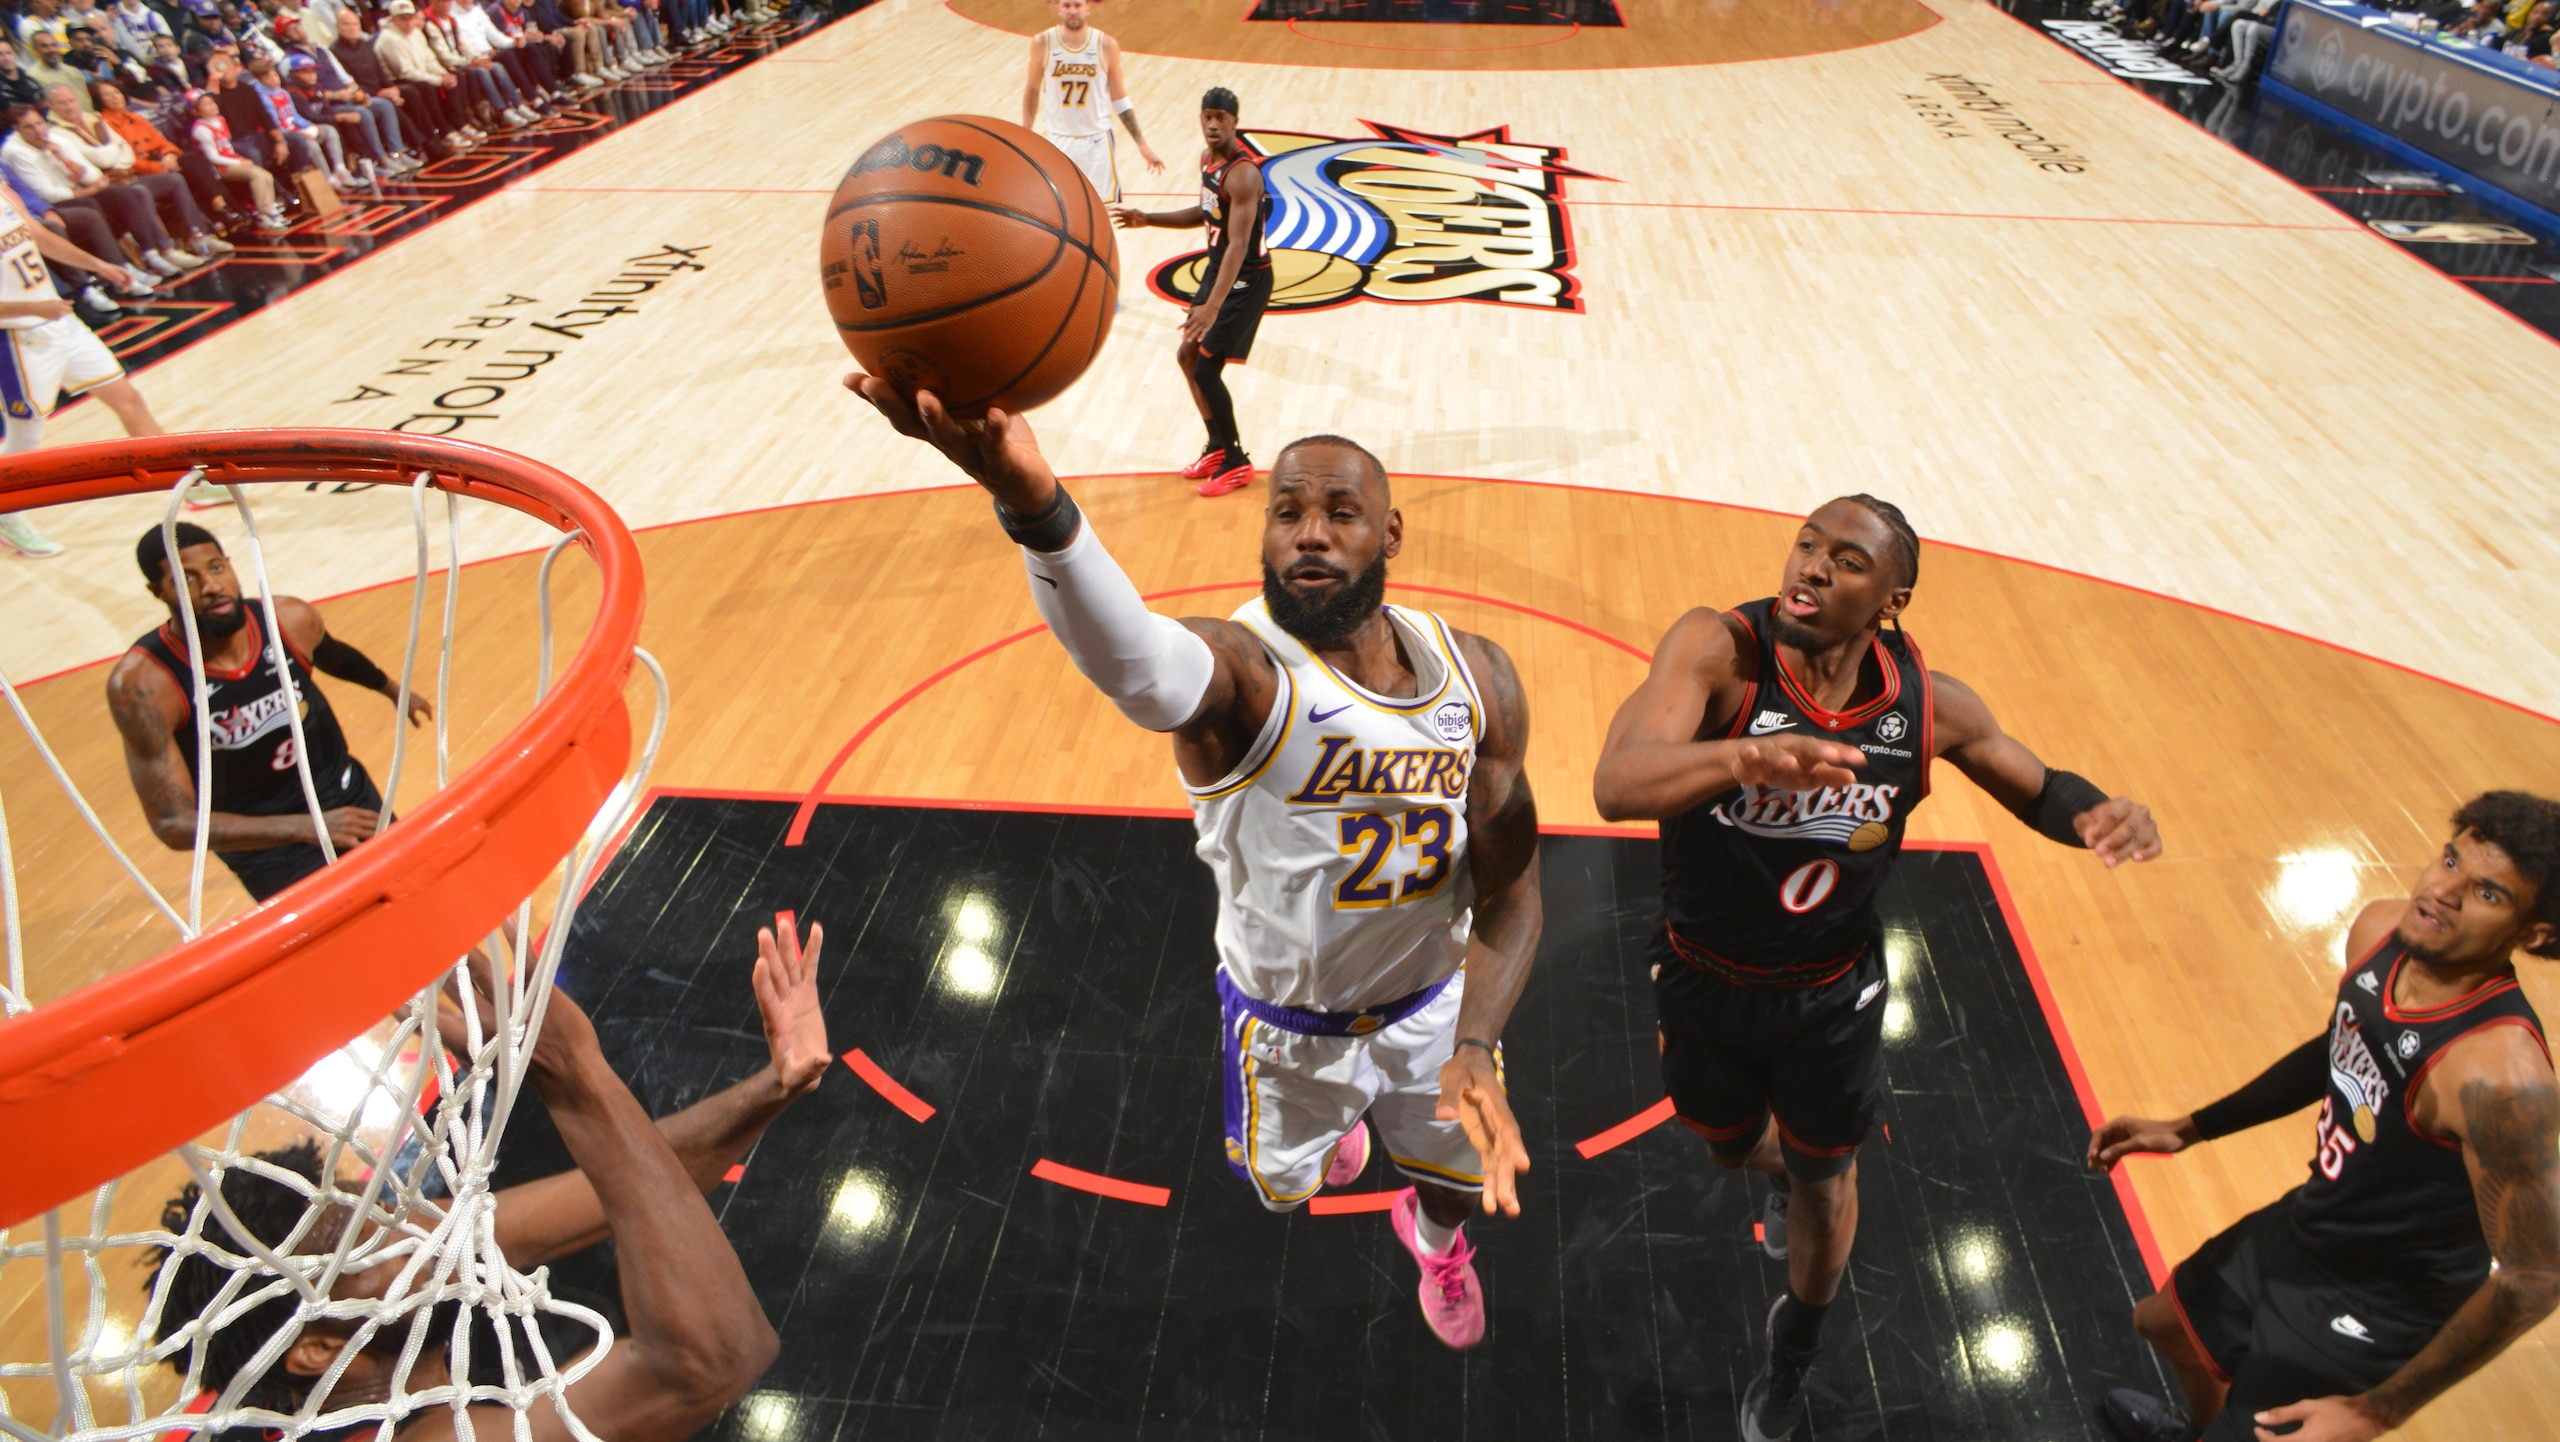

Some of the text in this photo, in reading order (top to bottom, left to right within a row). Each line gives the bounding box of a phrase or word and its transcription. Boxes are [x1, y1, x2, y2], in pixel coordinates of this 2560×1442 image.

[1051, 60, 1097, 77] LAKERS
[1061, 81, 1090, 108] 77
[1897, 93, 1975, 140] ARENA
[1925, 72, 2090, 174] xfinity mobile
[2346, 53, 2560, 188] crypto.com
[10, 249, 48, 291] 15
[529, 244, 712, 339] xfinity
[332, 293, 540, 404] ARENA
[1437, 713, 1472, 730] bibigo
[1757, 710, 1789, 727] NIKE
[270, 737, 300, 771] 8
[1285, 735, 1471, 806] LAKERS
[1860, 744, 1913, 759] crypto.com
[1333, 804, 1456, 911] 23
[1780, 858, 1840, 914] 0
